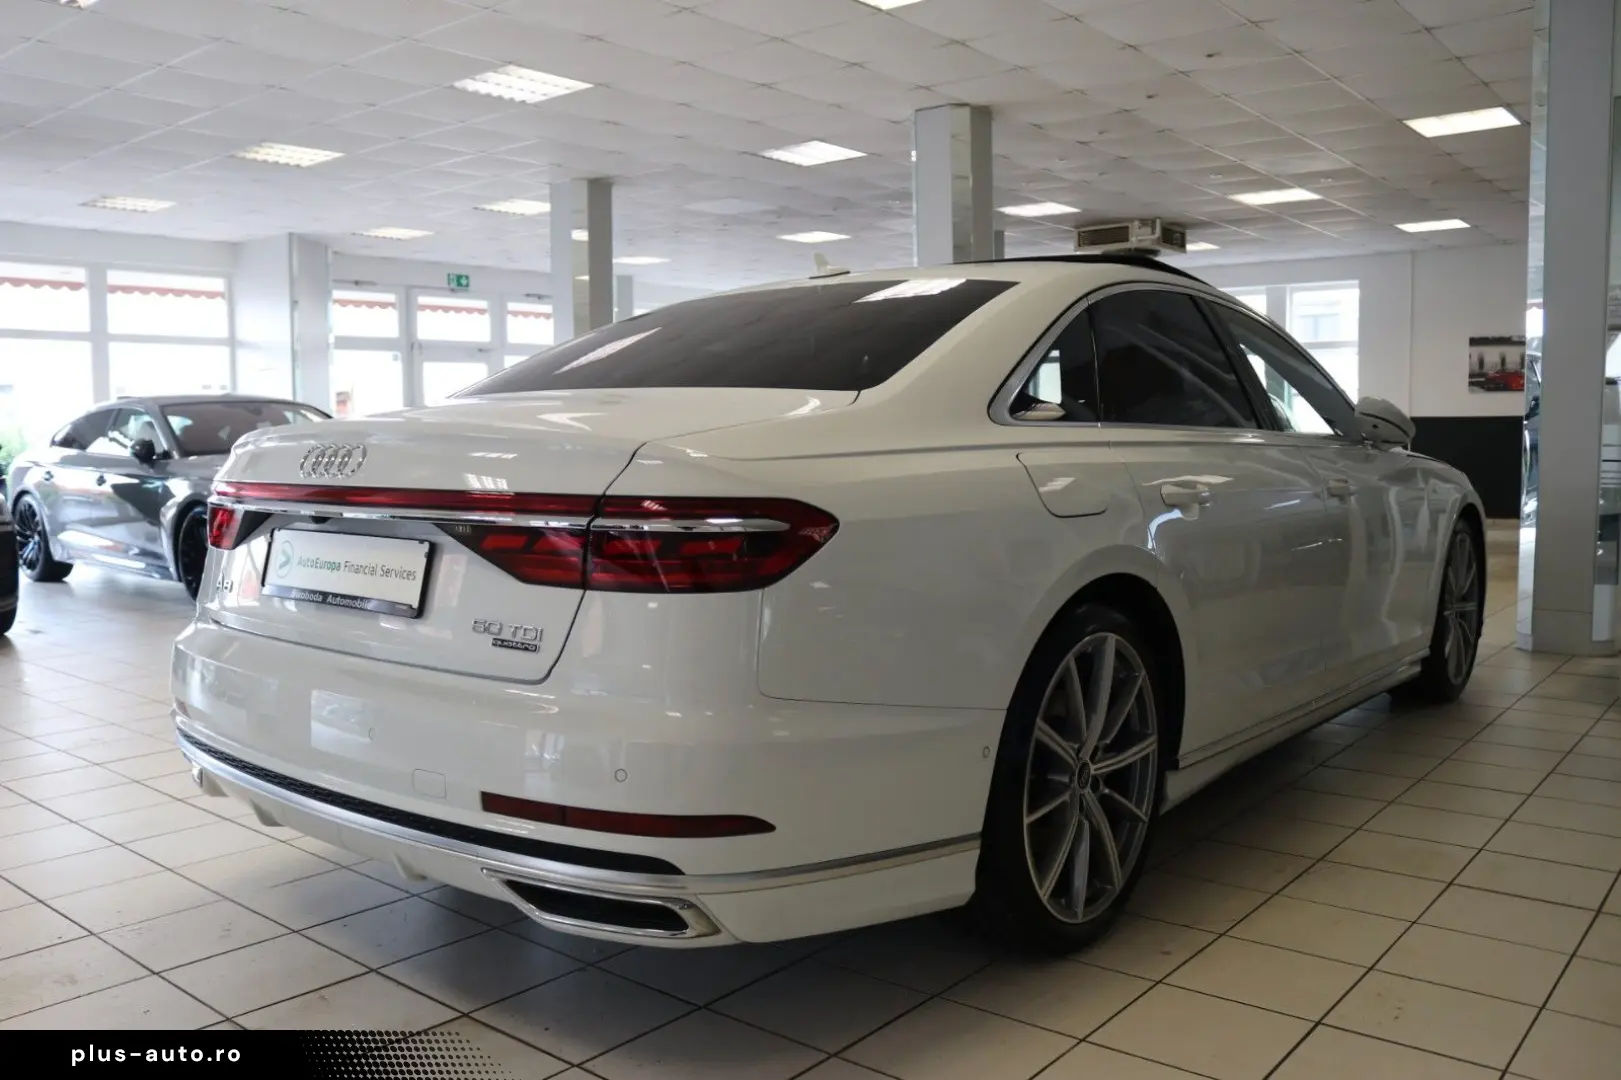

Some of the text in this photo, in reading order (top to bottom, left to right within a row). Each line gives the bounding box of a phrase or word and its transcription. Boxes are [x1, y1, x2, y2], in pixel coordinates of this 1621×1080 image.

[297, 556, 417, 581] AutoEuropa Financial Services
[508, 624, 543, 642] TDI
[492, 639, 539, 652] quattro
